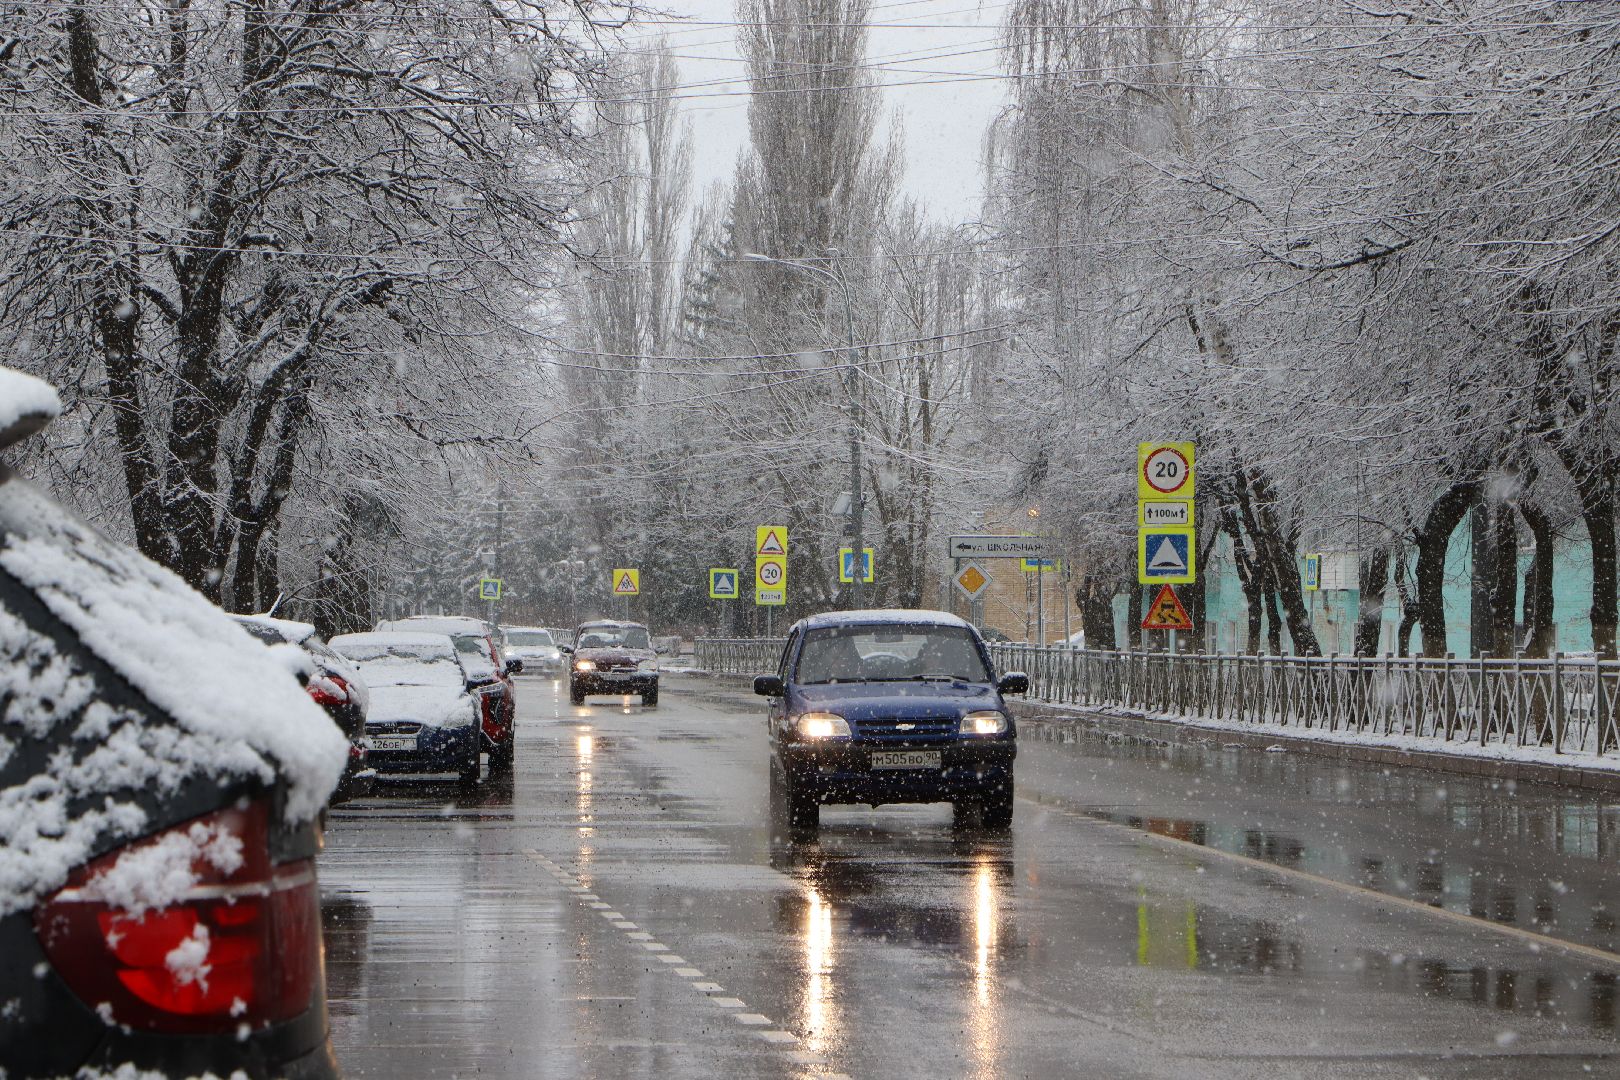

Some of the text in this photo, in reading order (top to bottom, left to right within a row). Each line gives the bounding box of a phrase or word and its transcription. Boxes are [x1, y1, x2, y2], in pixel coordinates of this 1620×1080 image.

[1155, 461, 1178, 478] 20
[987, 543, 1041, 552] ШКОЛЬНАЯ
[764, 568, 778, 579] 20
[372, 740, 400, 749] 126ОЕ
